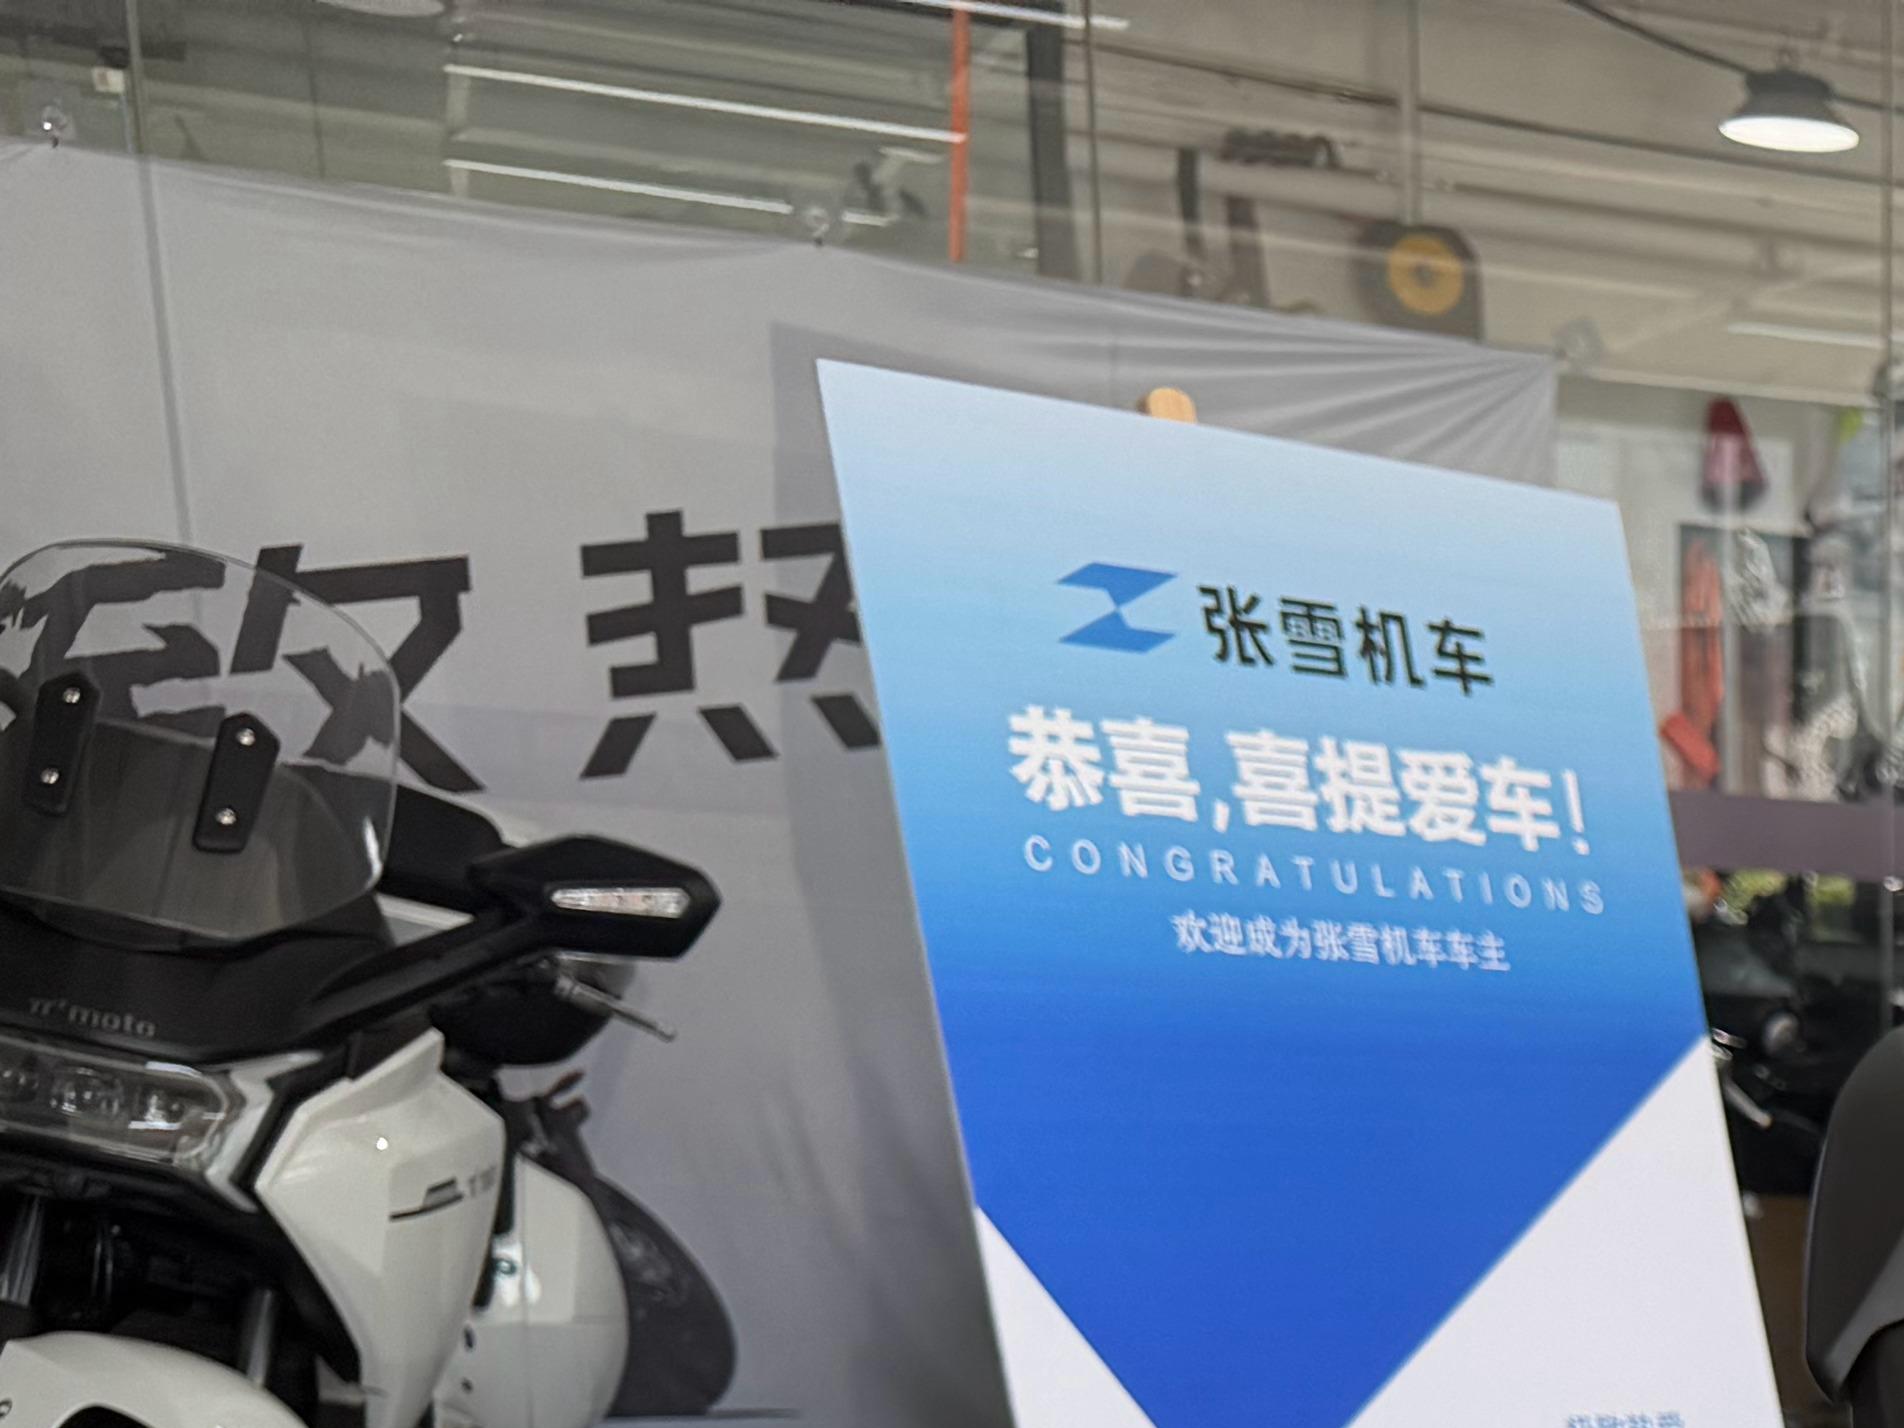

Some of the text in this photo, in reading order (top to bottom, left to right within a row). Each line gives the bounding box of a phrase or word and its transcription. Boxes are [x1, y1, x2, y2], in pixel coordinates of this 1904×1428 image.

[1198, 584, 1494, 695] 张雪机车
[1024, 834, 1603, 915] CONGRATULATIONS
[1171, 910, 1511, 971] 欢迎成为张雪机车车主
